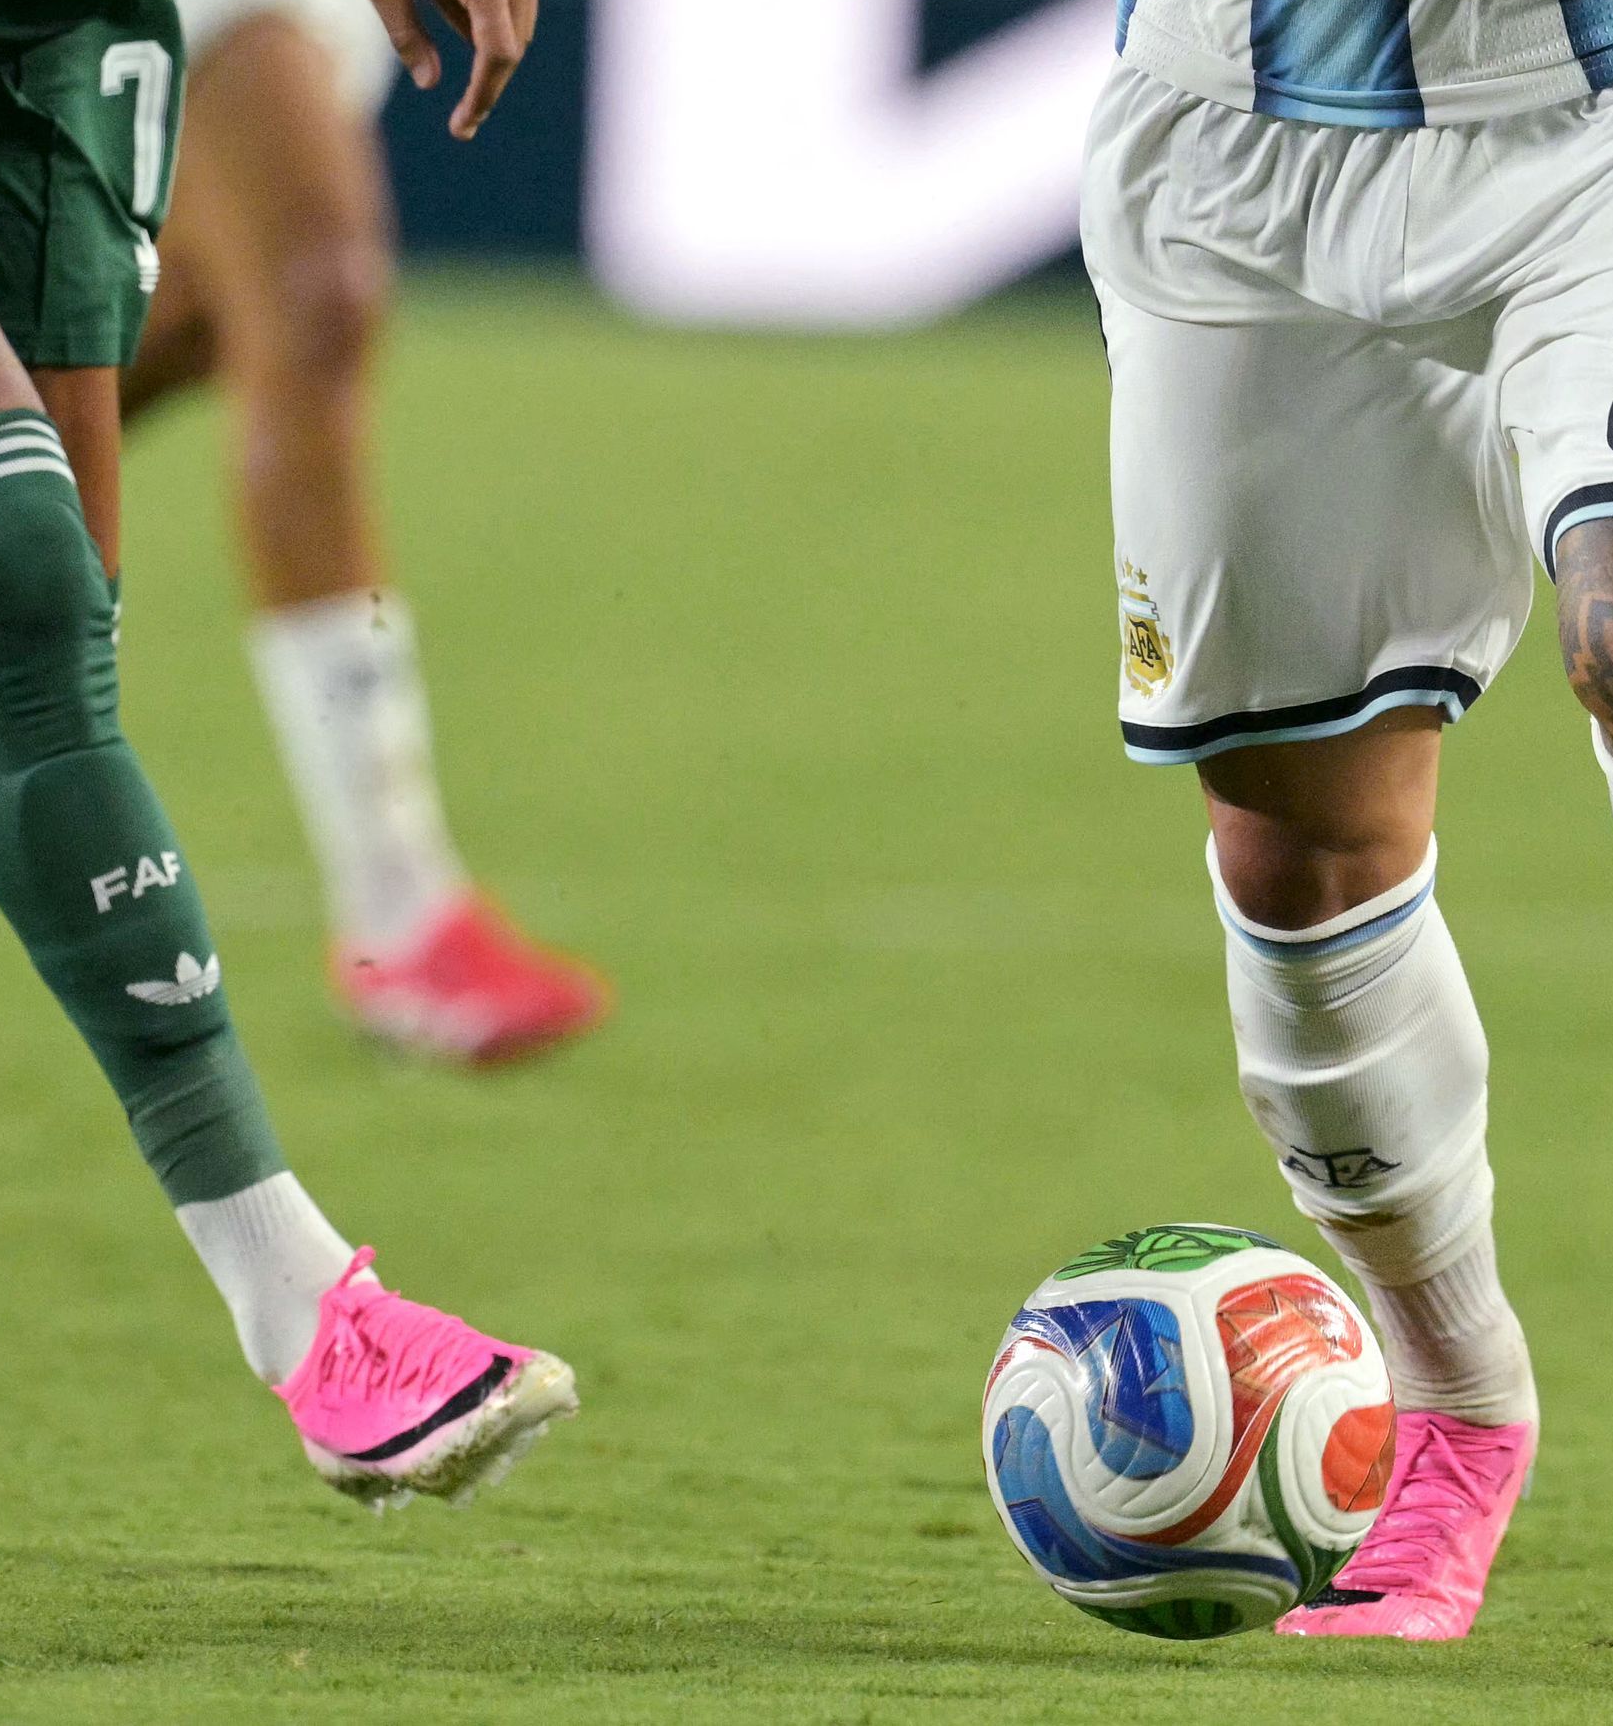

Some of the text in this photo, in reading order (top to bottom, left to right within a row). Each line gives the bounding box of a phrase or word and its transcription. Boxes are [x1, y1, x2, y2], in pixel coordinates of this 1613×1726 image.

[99, 39, 173, 218] 7
[1129, 615, 1163, 668] AFA
[90, 850, 182, 914] FAF
